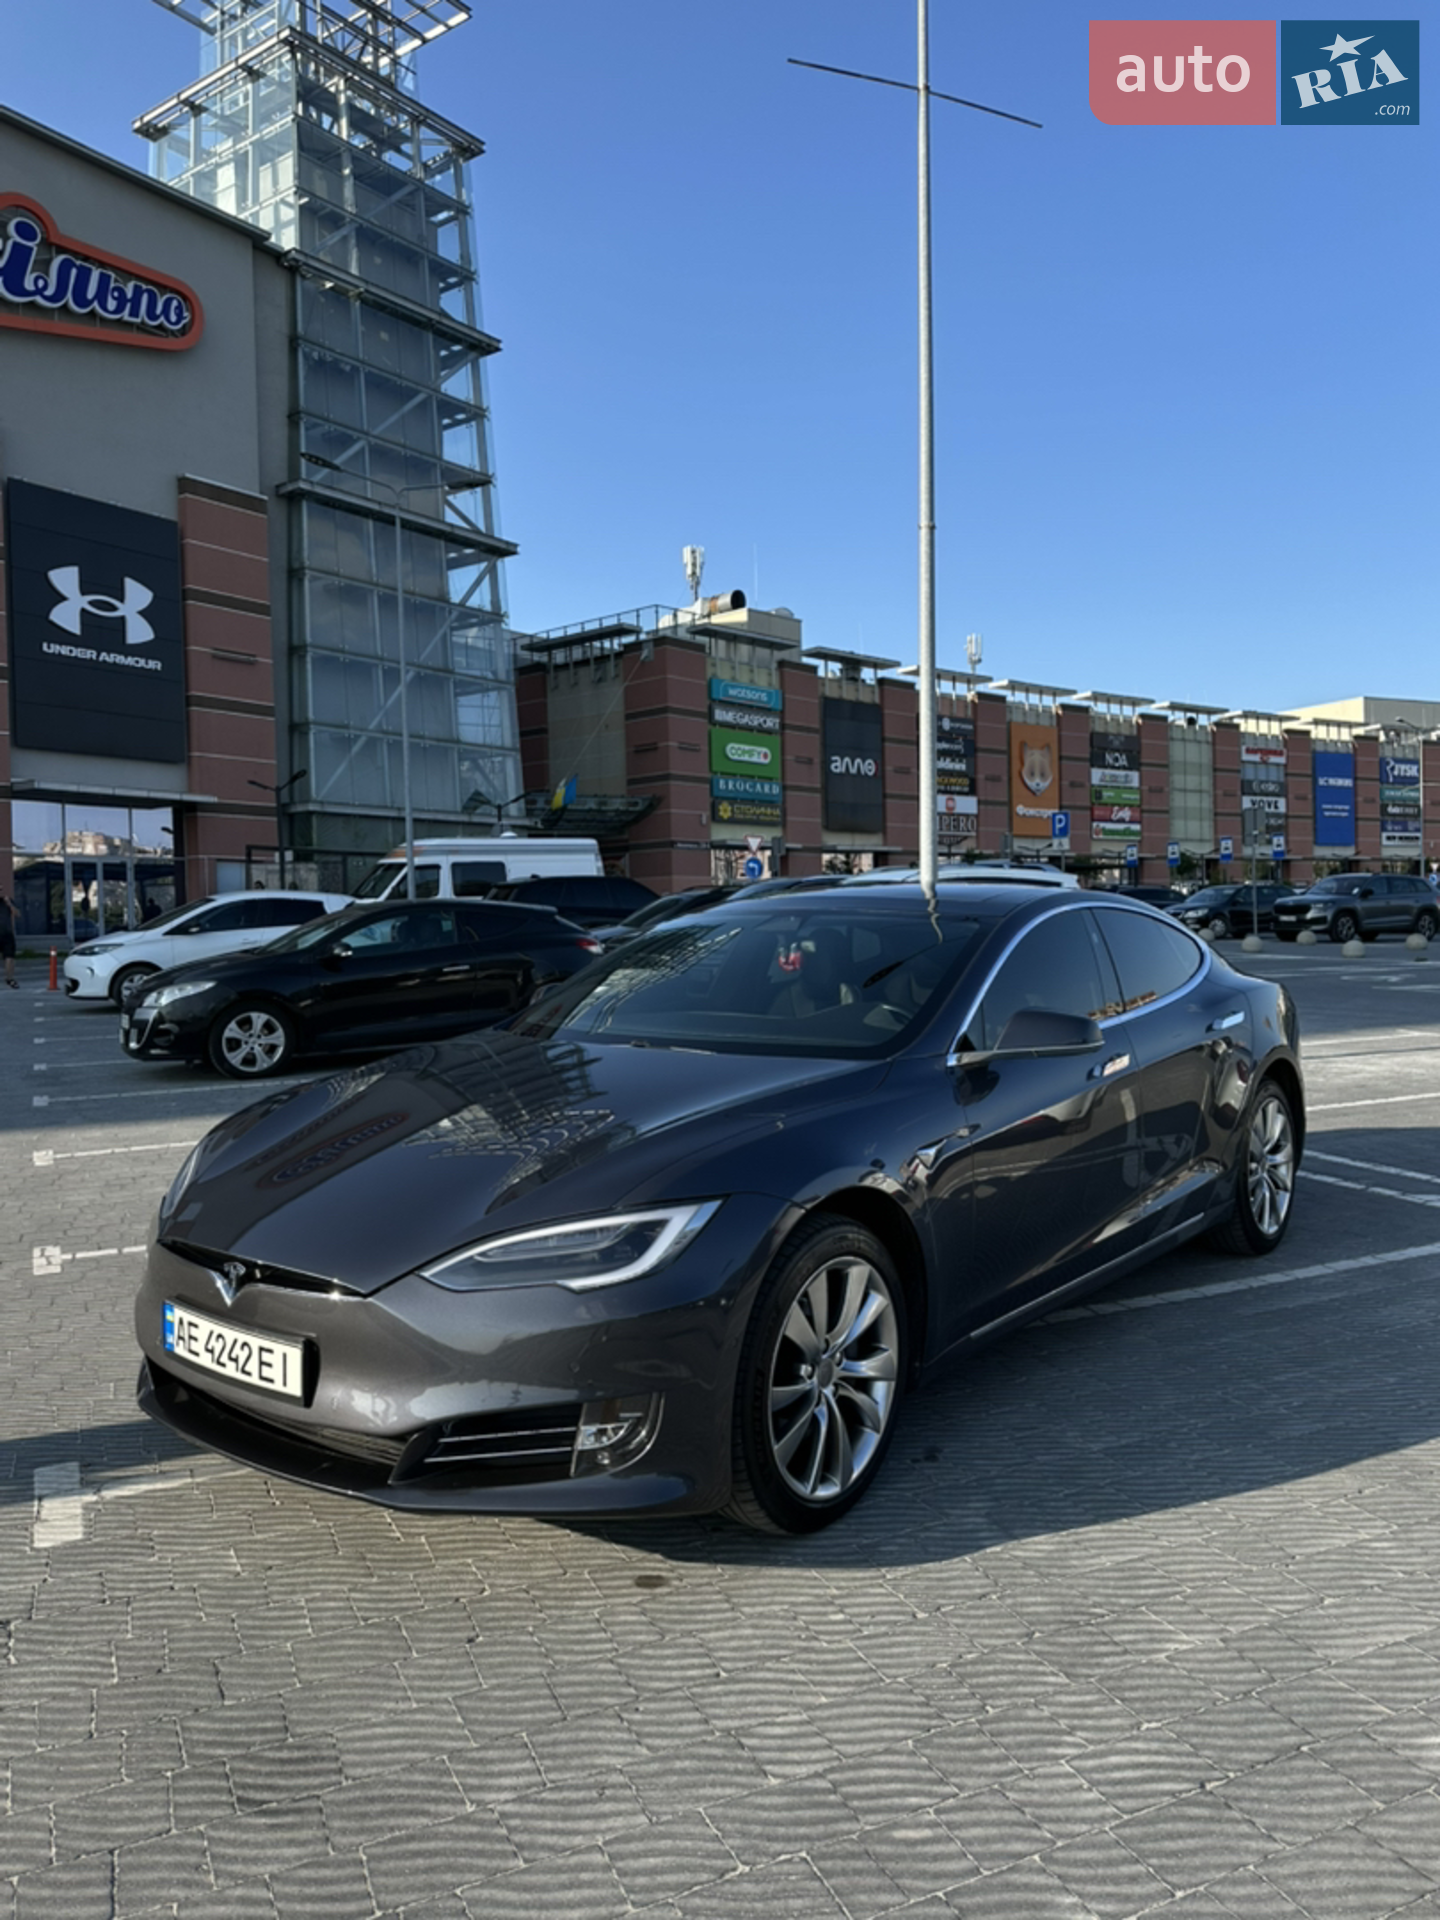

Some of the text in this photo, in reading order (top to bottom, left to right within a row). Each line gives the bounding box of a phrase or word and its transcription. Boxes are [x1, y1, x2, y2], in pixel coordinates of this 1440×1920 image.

[0, 217, 189, 330] ільпо
[42, 641, 162, 671] UNDER ARMOUR
[728, 686, 768, 702] watsons
[724, 710, 780, 730] MEGASPORT
[1393, 764, 1419, 777] JYSK
[719, 779, 780, 795] BROCARD
[1055, 814, 1066, 835] P
